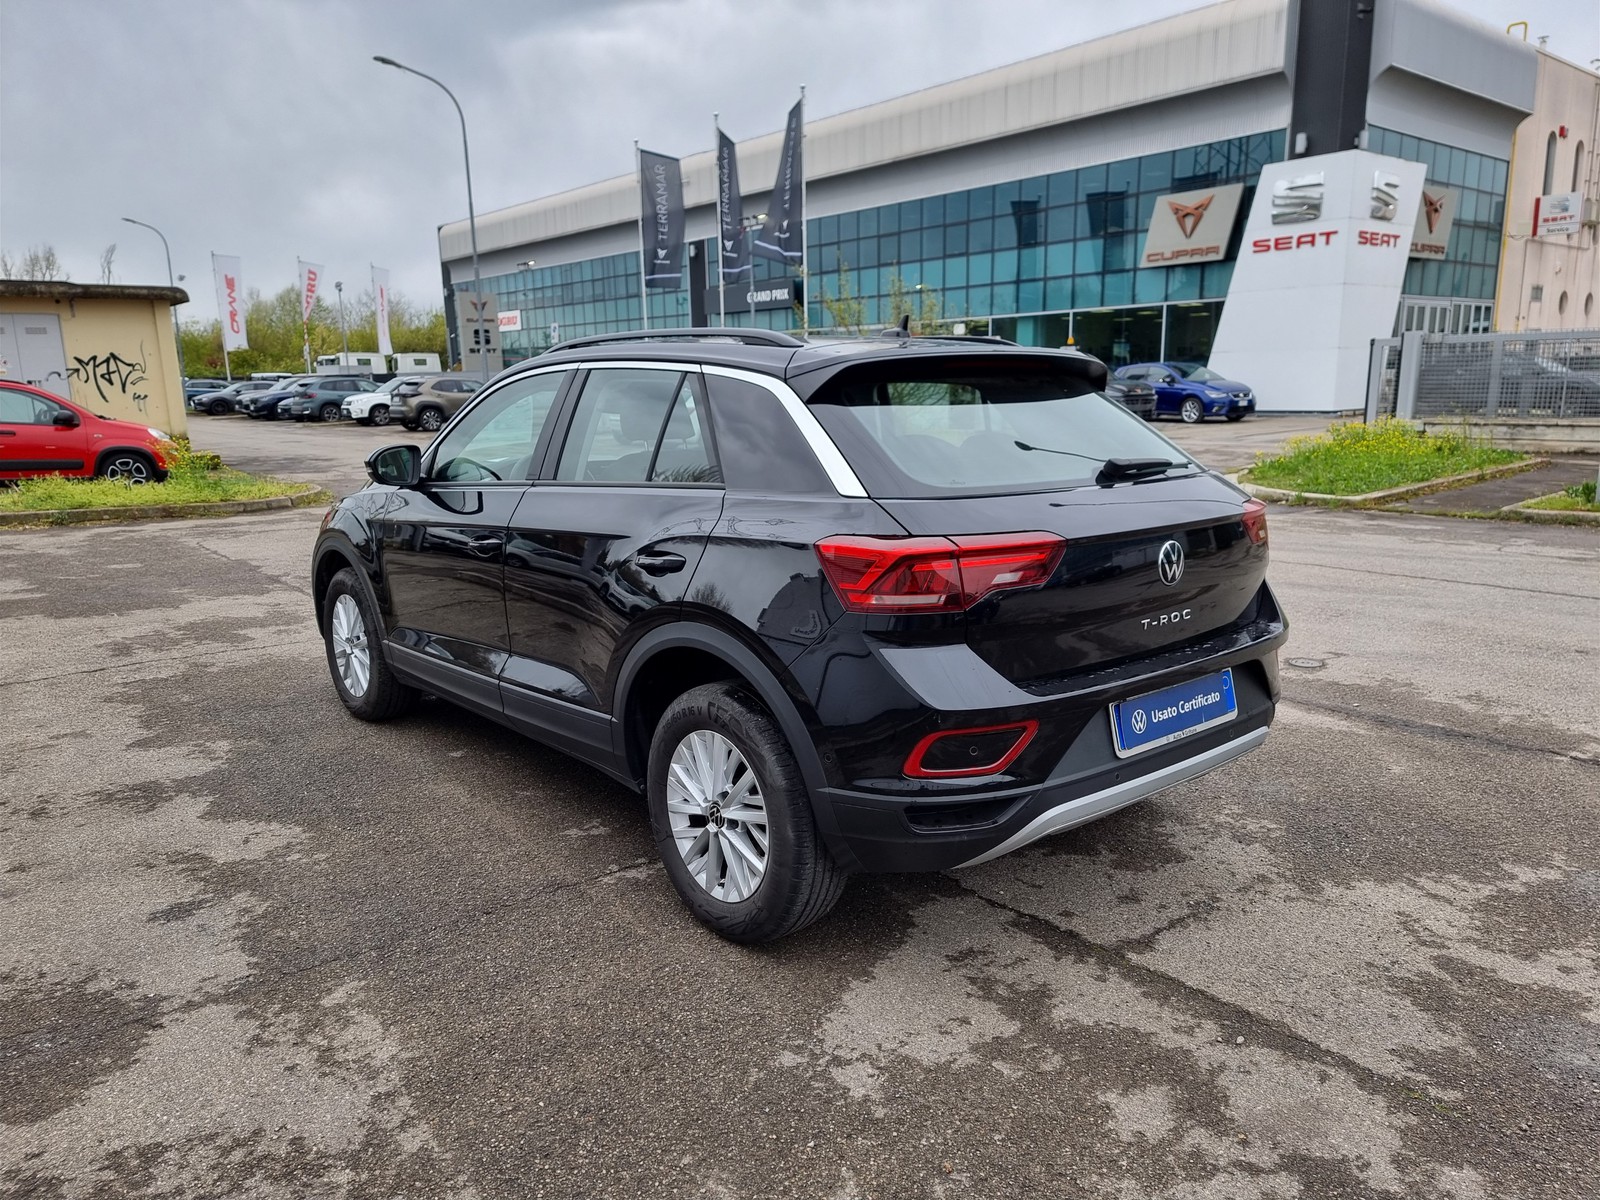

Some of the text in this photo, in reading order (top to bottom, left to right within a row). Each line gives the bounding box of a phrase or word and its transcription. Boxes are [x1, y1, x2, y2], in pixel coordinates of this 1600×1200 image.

[720, 146, 732, 232] TERRAMAR
[654, 163, 669, 241] TERRAMAR
[1542, 214, 1574, 223] SEAT
[1252, 230, 1338, 254] SEAT
[1357, 229, 1401, 248] SEAT
[1146, 245, 1220, 263] CUPRA
[224, 274, 240, 334] CRANE
[1140, 608, 1192, 631] T-ROC
[1151, 707, 1177, 723] Usato
[1178, 691, 1221, 714] Certificato
